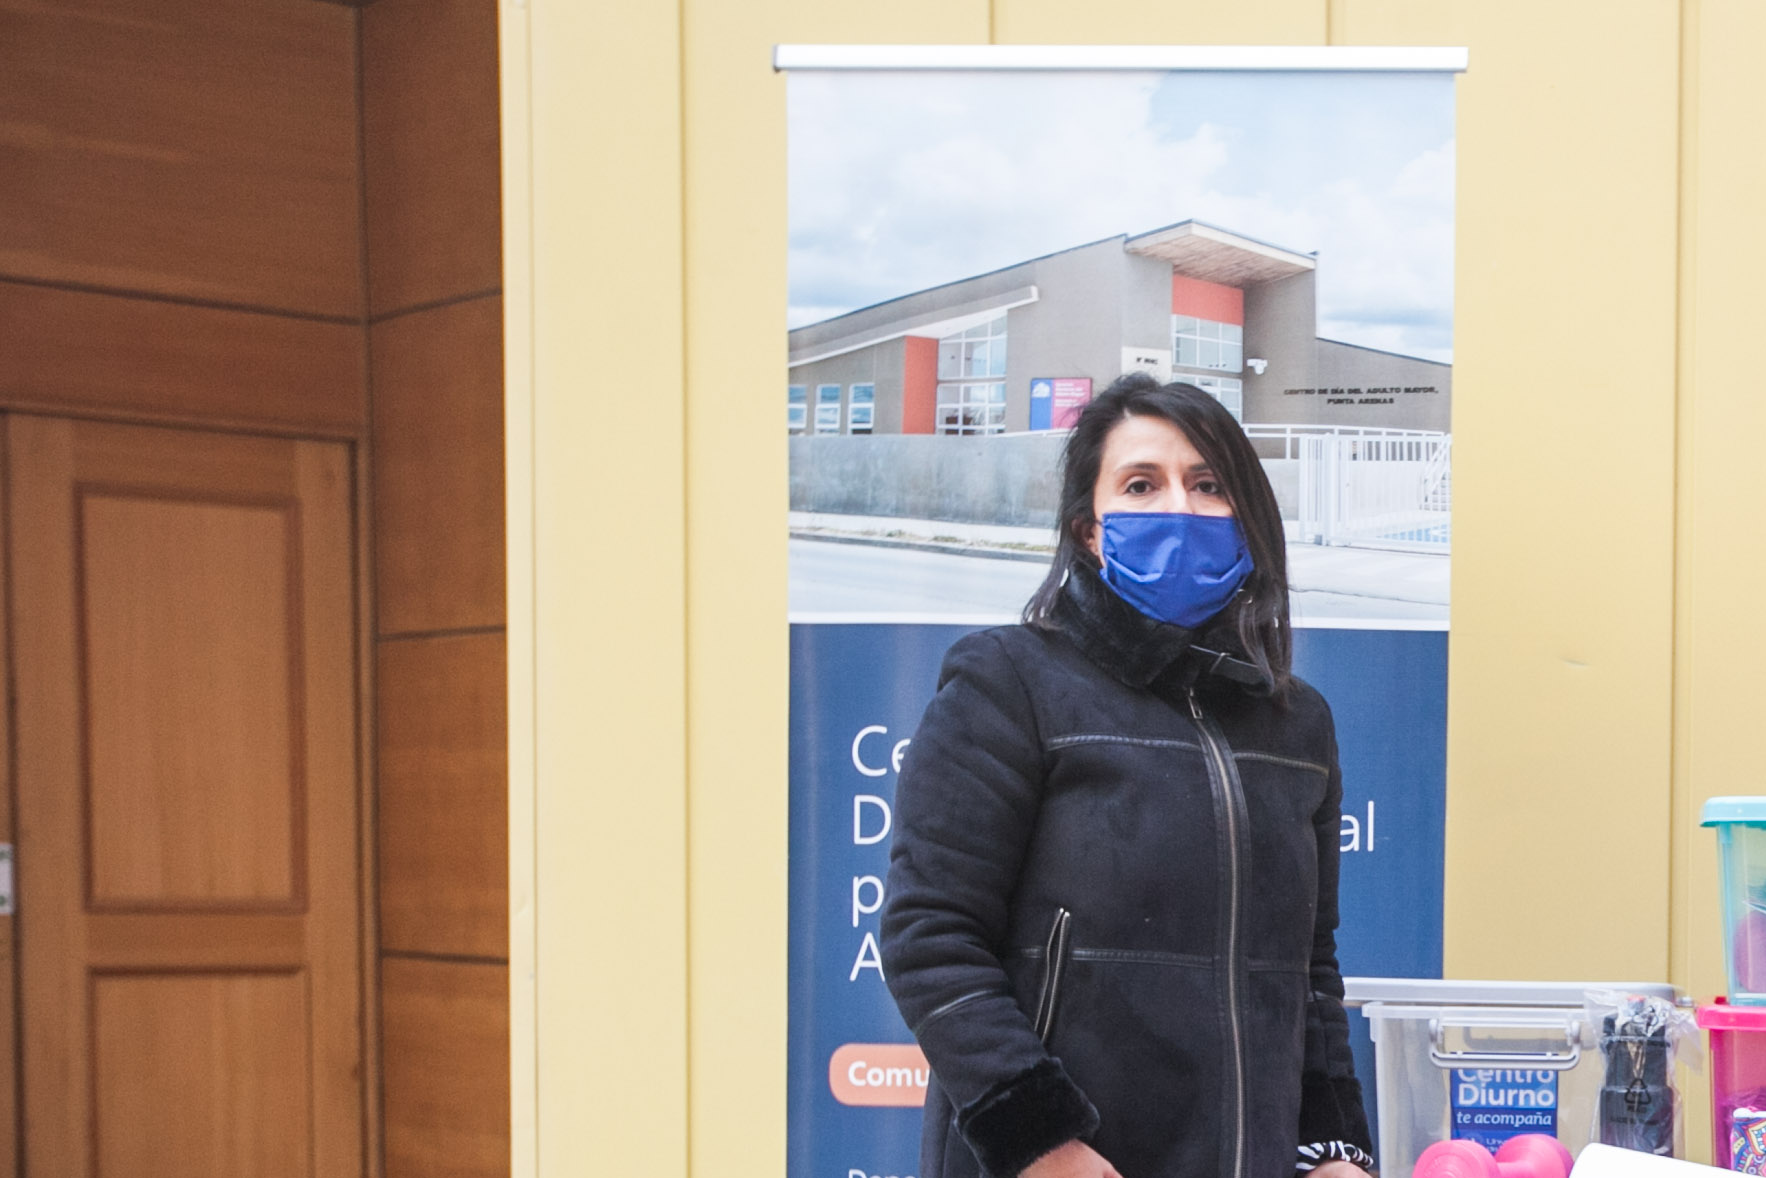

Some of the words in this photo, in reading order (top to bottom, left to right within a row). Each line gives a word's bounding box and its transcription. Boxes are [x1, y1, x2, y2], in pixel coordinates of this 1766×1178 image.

[1457, 1068, 1554, 1083] Centro
[1459, 1083, 1554, 1106] Diurno
[1457, 1112, 1471, 1123] te
[1474, 1112, 1552, 1127] acompaña
